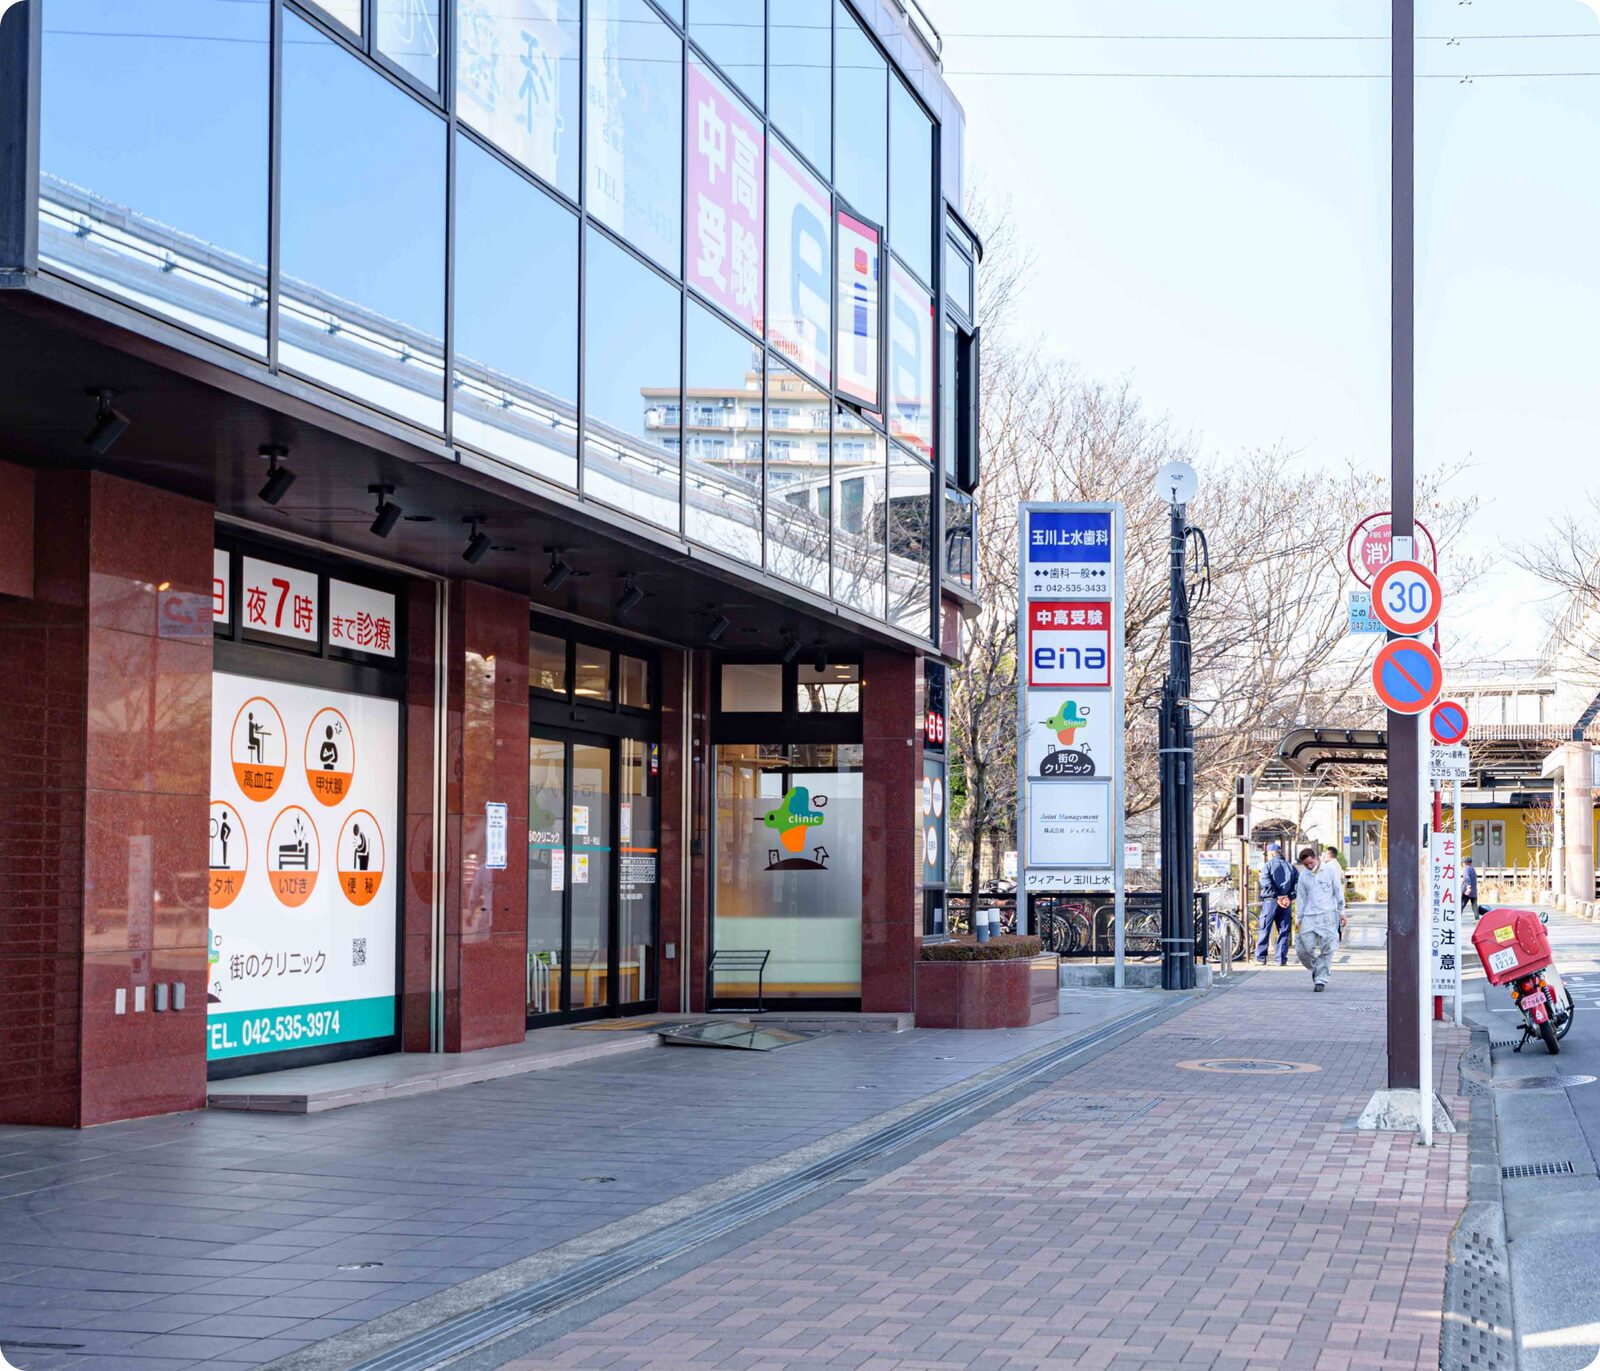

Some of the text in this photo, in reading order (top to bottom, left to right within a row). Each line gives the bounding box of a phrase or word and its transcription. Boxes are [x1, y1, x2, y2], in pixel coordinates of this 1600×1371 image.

[697, 95, 759, 222] 中高
[697, 190, 760, 317] 受験
[1032, 529, 1108, 546] 玉川上水歯科
[1050, 568, 1091, 579] 歯科一般
[1046, 584, 1107, 592] 042-535-3433
[1389, 581, 1426, 613] 30
[247, 577, 314, 634] 夜7時
[332, 611, 392, 650] まで診療
[1036, 610, 1103, 626] 中高受験
[1034, 647, 1106, 669] eina
[1063, 718, 1086, 727] clinic
[1057, 753, 1079, 764] 街の
[1045, 764, 1092, 774] クリニック
[1431, 769, 1467, 777] ここから 10m
[243, 770, 274, 790] 高血圧
[315, 776, 343, 795] 甲状腺
[788, 813, 820, 824] clinic
[1059, 813, 1099, 821] Management
[279, 877, 308, 895] いびき
[1028, 874, 1111, 886] ヴィアーレ 玉川上水
[1440, 839, 1455, 970] ちかんに注意
[230, 950, 327, 981] 街のクリニック
[1495, 956, 1516, 970] 1212
[242, 1010, 340, 1047] 042-535-3974
